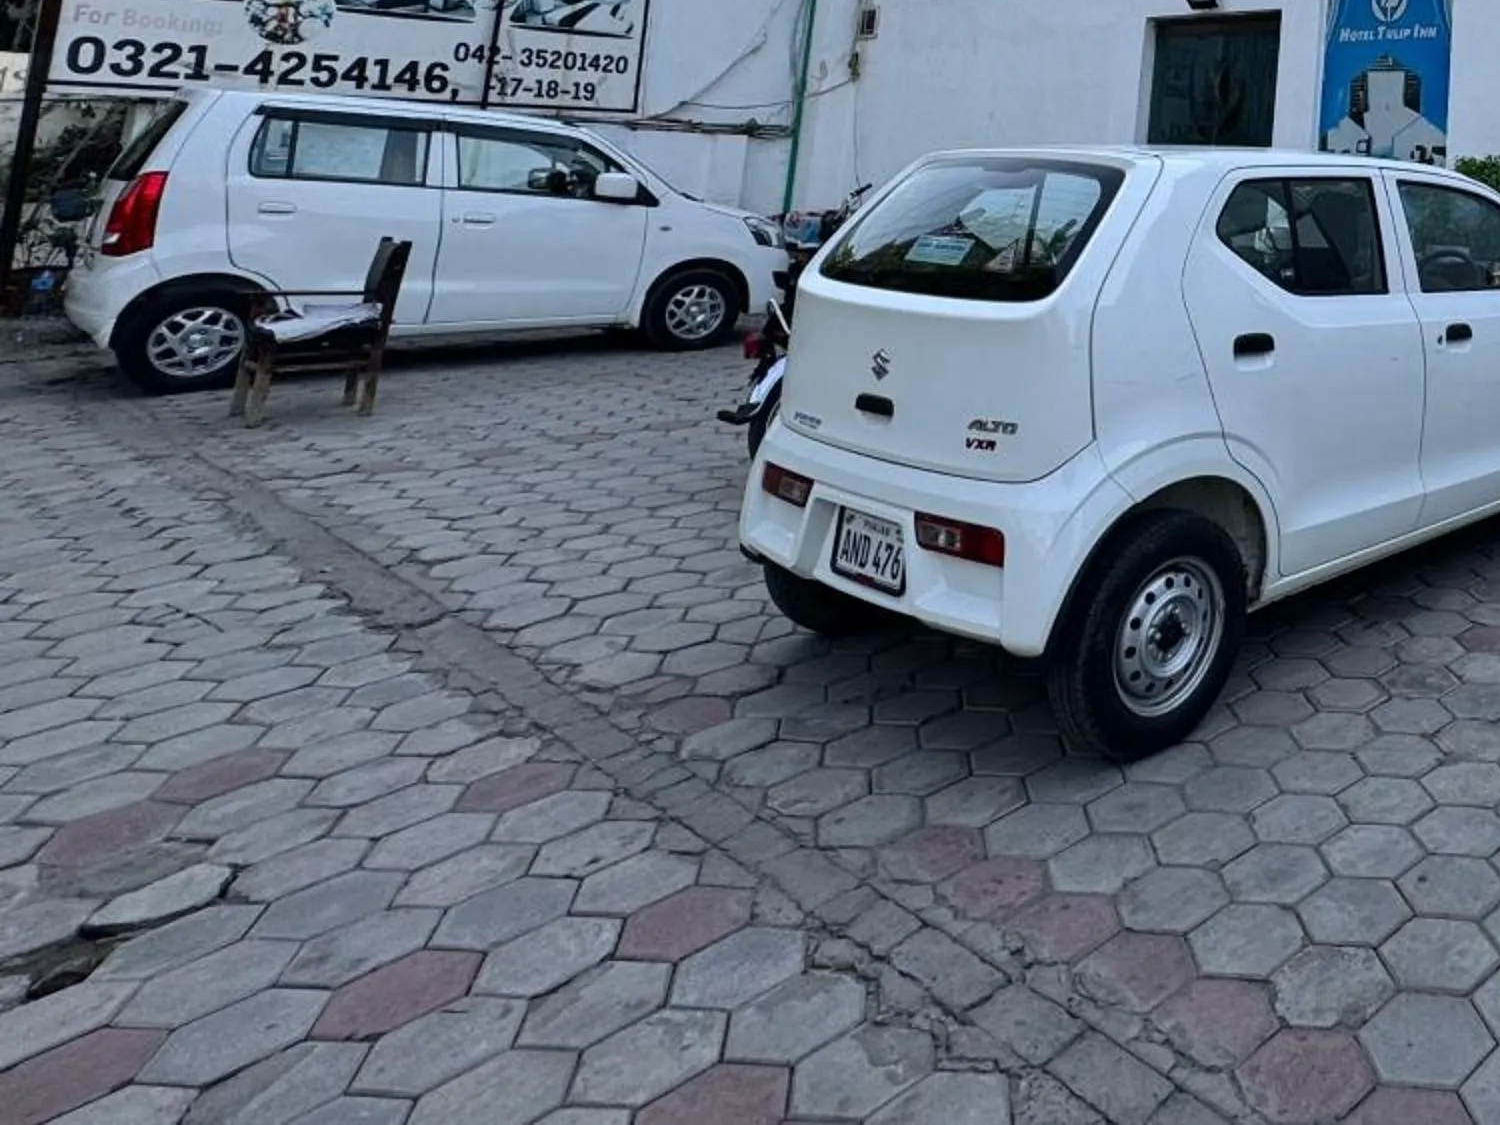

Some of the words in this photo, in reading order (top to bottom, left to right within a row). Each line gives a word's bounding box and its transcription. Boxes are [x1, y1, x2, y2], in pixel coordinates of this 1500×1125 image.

[72, 3, 116, 24] For
[519, 47, 629, 75] 35201420
[840, 528, 871, 569] AND
[872, 539, 902, 580] 476
